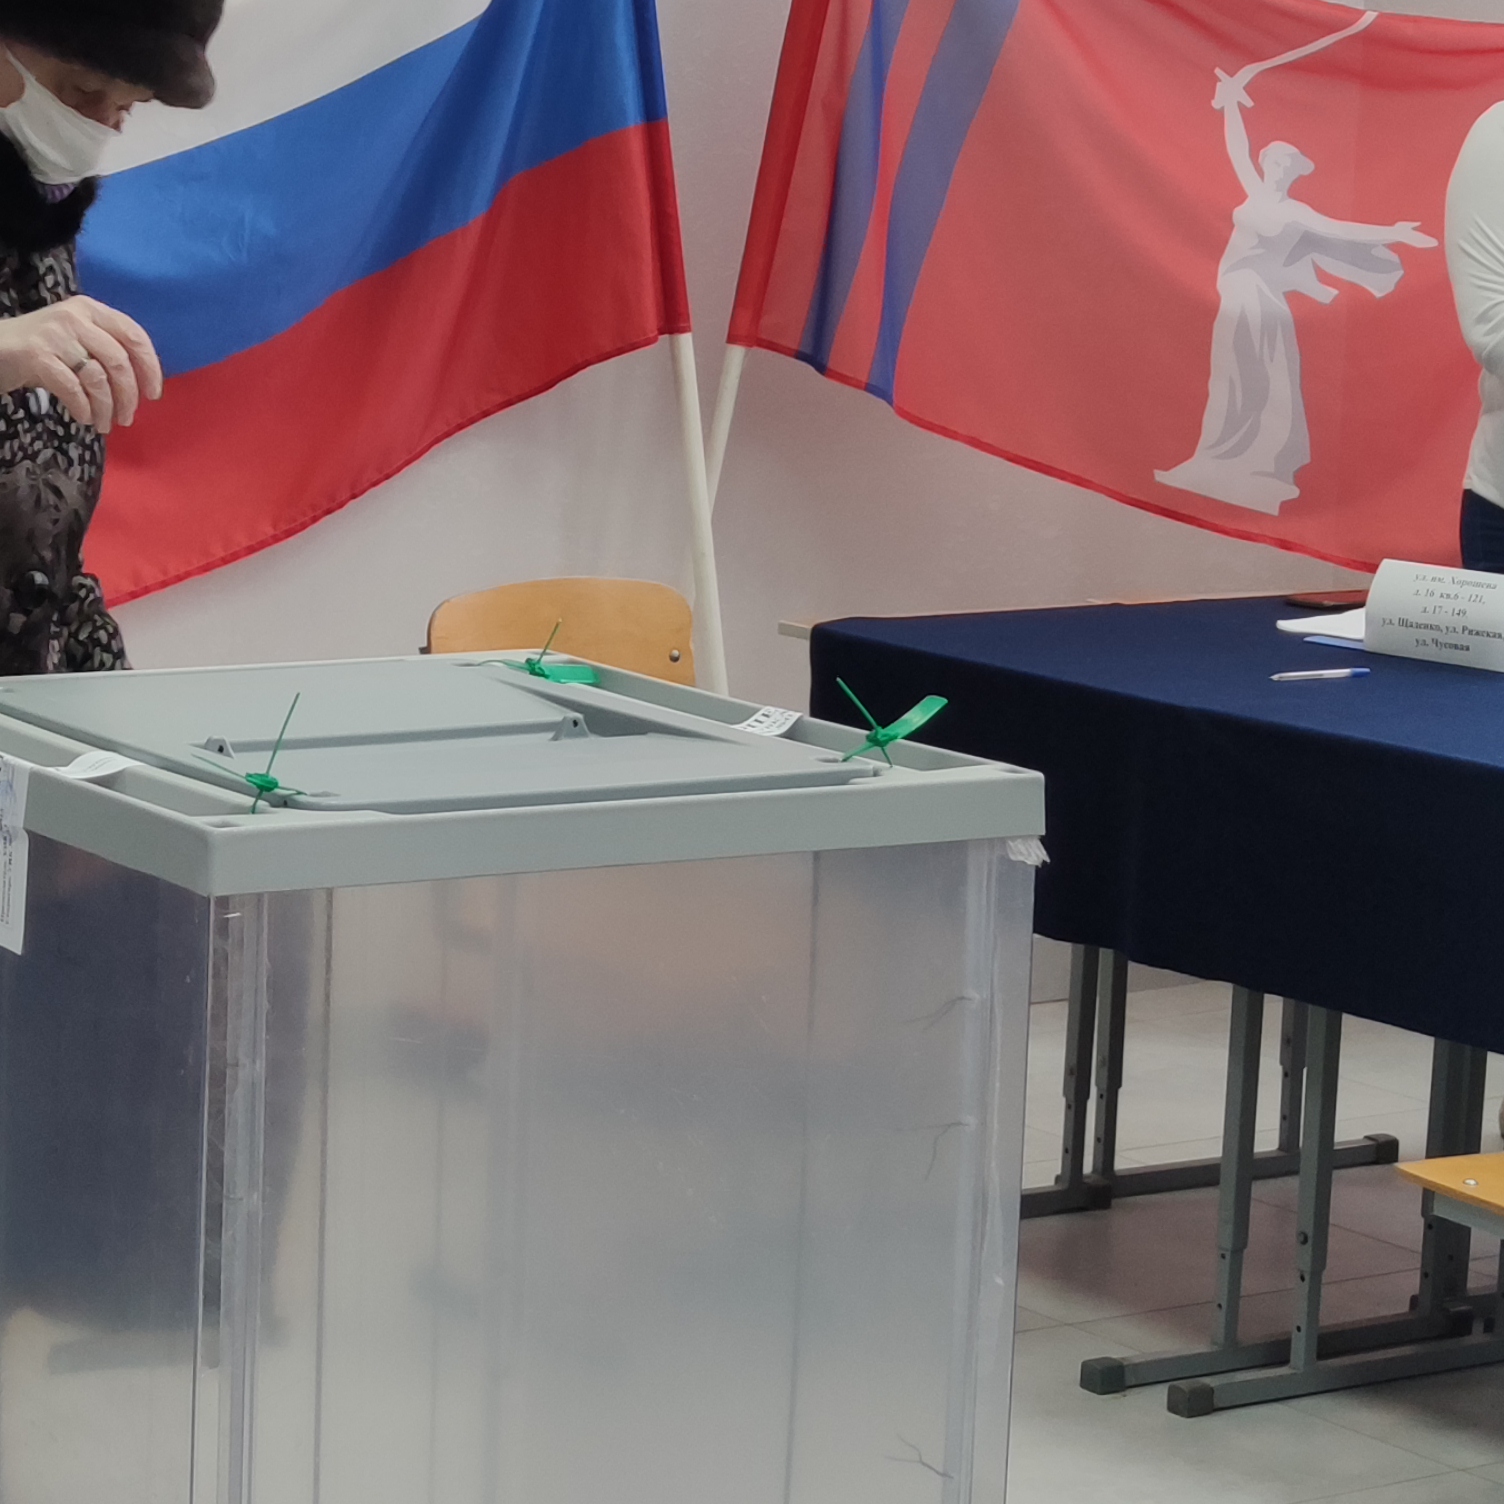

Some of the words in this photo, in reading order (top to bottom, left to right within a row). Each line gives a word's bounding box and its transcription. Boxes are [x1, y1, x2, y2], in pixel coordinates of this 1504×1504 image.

[1448, 576, 1497, 590] Хорошева
[1432, 605, 1442, 614] 17
[1381, 617, 1395, 627] ул.
[1445, 625, 1459, 635] ул.
[1415, 638, 1429, 647] ул.
[1432, 638, 1470, 652] Чусовая
